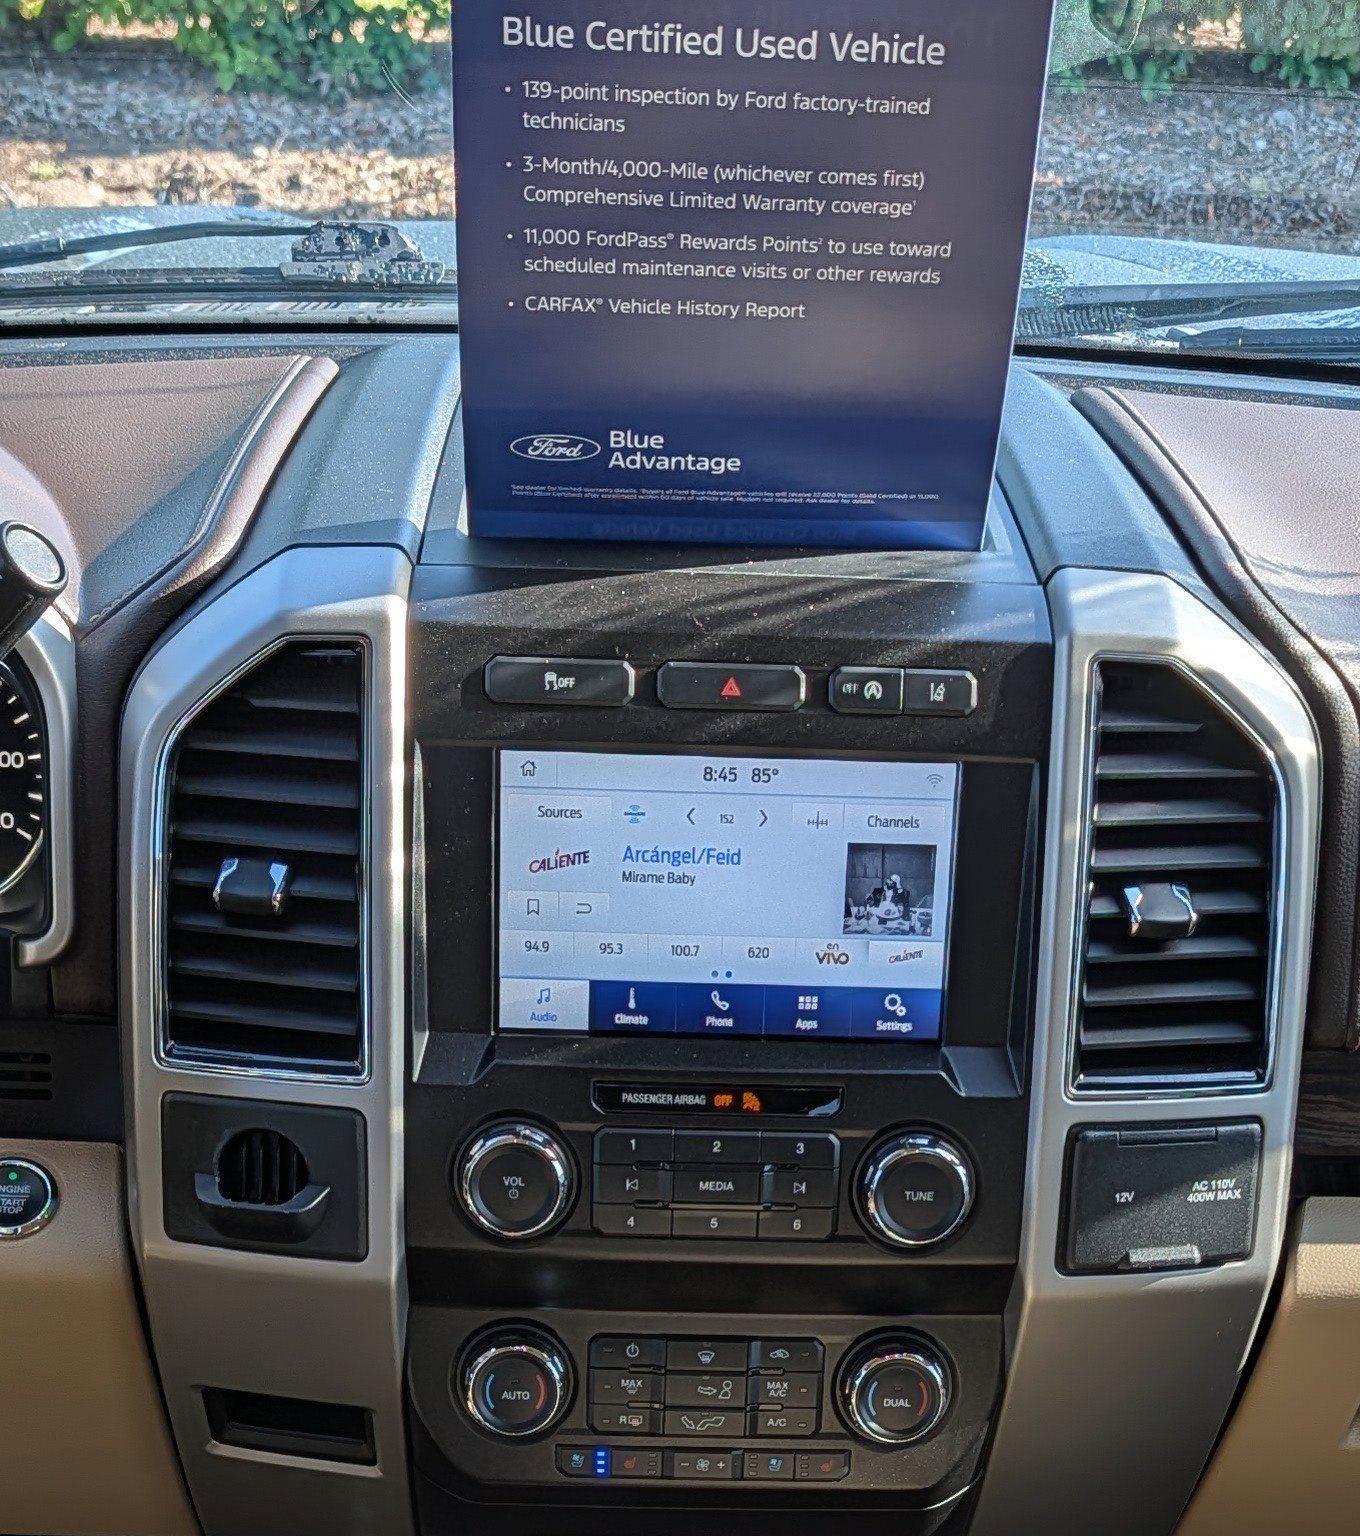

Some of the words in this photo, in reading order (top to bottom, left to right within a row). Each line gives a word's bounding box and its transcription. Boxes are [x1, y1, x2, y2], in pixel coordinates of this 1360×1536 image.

[502, 16, 575, 49] Blue
[585, 20, 722, 56] Certified
[735, 28, 817, 61] Used
[830, 31, 945, 66] Vehicle
[522, 80, 609, 104] 139-point
[614, 84, 710, 108] inspection
[716, 88, 738, 110] by
[745, 90, 786, 109] Ford
[792, 92, 931, 117] factory-trained
[522, 112, 625, 133] technicians
[523, 156, 708, 181] 3-Month/4,000-Mile
[714, 162, 813, 185] (whichever
[818, 169, 877, 185] comes
[883, 168, 925, 190] first)
[524, 186, 663, 210] Comprehensive
[669, 189, 736, 209] Limited
[743, 192, 826, 215] Warranty
[523, 228, 580, 248] 11,000
[680, 234, 756, 252] Rewards
[828, 239, 846, 254] to
[852, 242, 883, 255] use
[889, 240, 951, 258] toward
[524, 256, 616, 277] scheduled
[622, 259, 736, 278] maintenance
[742, 262, 787, 279] visits
[792, 266, 811, 281] or
[816, 264, 864, 281] other
[870, 266, 941, 284] rewards
[609, 299, 671, 315] Vehicle
[677, 301, 740, 319] History
[746, 303, 806, 320] Report
[610, 431, 664, 450] Blue
[527, 438, 582, 459] Ford
[609, 452, 741, 475] Advantage
[558, 677, 576, 688] OFF
[703, 766, 738, 783] 8:45
[538, 806, 582, 819] Sources
[720, 814, 735, 825] 152
[866, 814, 920, 830] Channels
[621, 845, 742, 867] Arcángel/Feid
[621, 871, 665, 884] Mirame
[667, 872, 697, 886] Baby
[525, 940, 550, 953] 94.9
[599, 942, 624, 955] 95.3
[670, 944, 701, 957] 100.7
[747, 947, 770, 959] 620
[815, 952, 850, 965] VIVO
[530, 1011, 558, 1023] Audio
[614, 1013, 649, 1027] Climate
[705, 1015, 734, 1028] Phone
[795, 1018, 819, 1031] Apps
[876, 1020, 913, 1033] Settings
[621, 1092, 673, 1106] PASSENGER
[674, 1094, 707, 1107] AIRBAG
[714, 1094, 734, 1107] OFF
[628, 1139, 636, 1152] 1
[712, 1140, 722, 1153] 2
[796, 1142, 805, 1155] 3
[502, 1175, 525, 1188] VOL
[699, 1180, 734, 1193] MEDIA
[1192, 1180, 1209, 1191] AC
[1210, 1178, 1236, 1190] 110V
[904, 1190, 934, 1202] TUNE
[1114, 1191, 1135, 1203] 12V
[1187, 1191, 1215, 1203] 400W
[1216, 1189, 1241, 1201] MAX
[626, 1216, 635, 1228] 4
[709, 1217, 718, 1230] 5
[793, 1219, 801, 1231] 6
[621, 1379, 643, 1388] MAX
[766, 1381, 789, 1390] MAX
[501, 1389, 531, 1401] AUTO
[768, 1389, 787, 1398] A/C
[883, 1397, 912, 1409] DUAL
[767, 1418, 787, 1427] A/C
